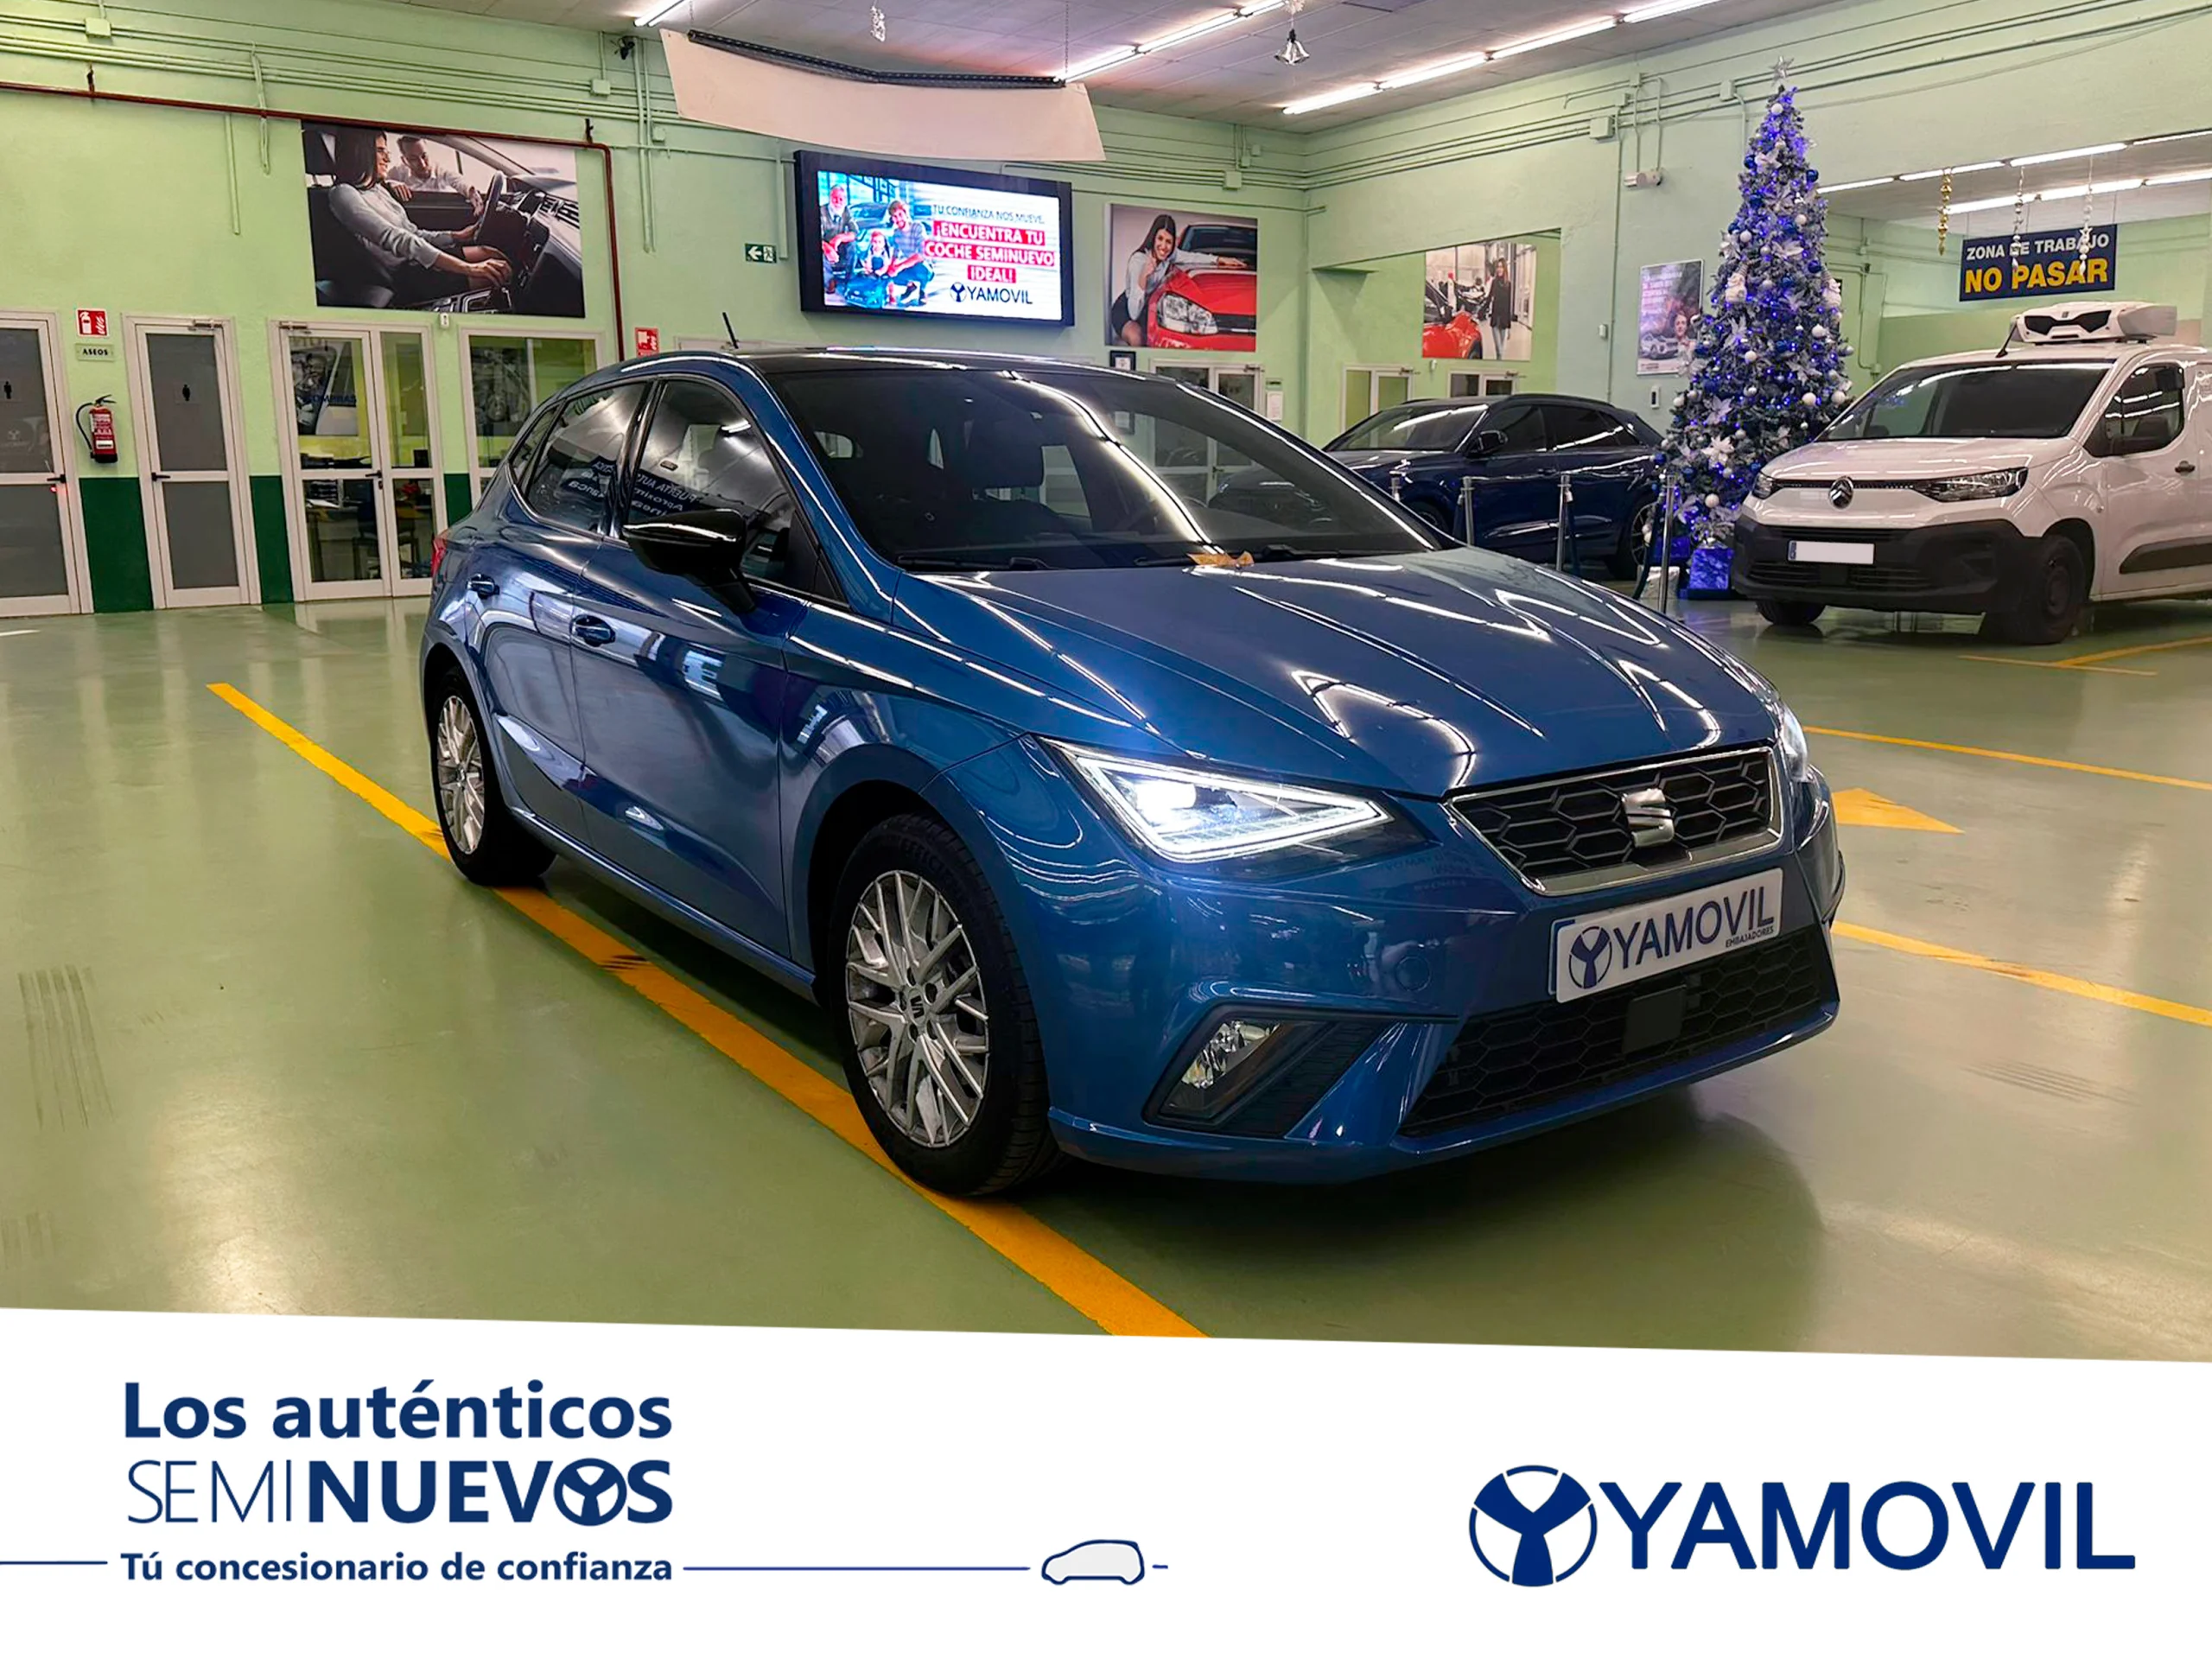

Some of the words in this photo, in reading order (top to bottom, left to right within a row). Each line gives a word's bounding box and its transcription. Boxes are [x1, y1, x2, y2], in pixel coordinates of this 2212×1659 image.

[933, 204, 944, 215] TU
[945, 206, 994, 219] CONFIANZA
[996, 210, 1014, 221] NOS
[936, 222, 1023, 244] ¡ENCUENTRA
[1026, 231, 1044, 245] TU
[925, 243, 973, 259] COCHE
[976, 247, 1054, 266] SEMINUEVO
[1966, 244, 2005, 261] ZONA
[971, 267, 1014, 283] IDEAL!
[1964, 266, 2003, 293] NO
[2011, 257, 2108, 290] PASAR
[967, 286, 1033, 305] YAMOVIL
[1613, 886, 1775, 969] YAMOVIL
[1725, 925, 1775, 949] EMBAJADORES
